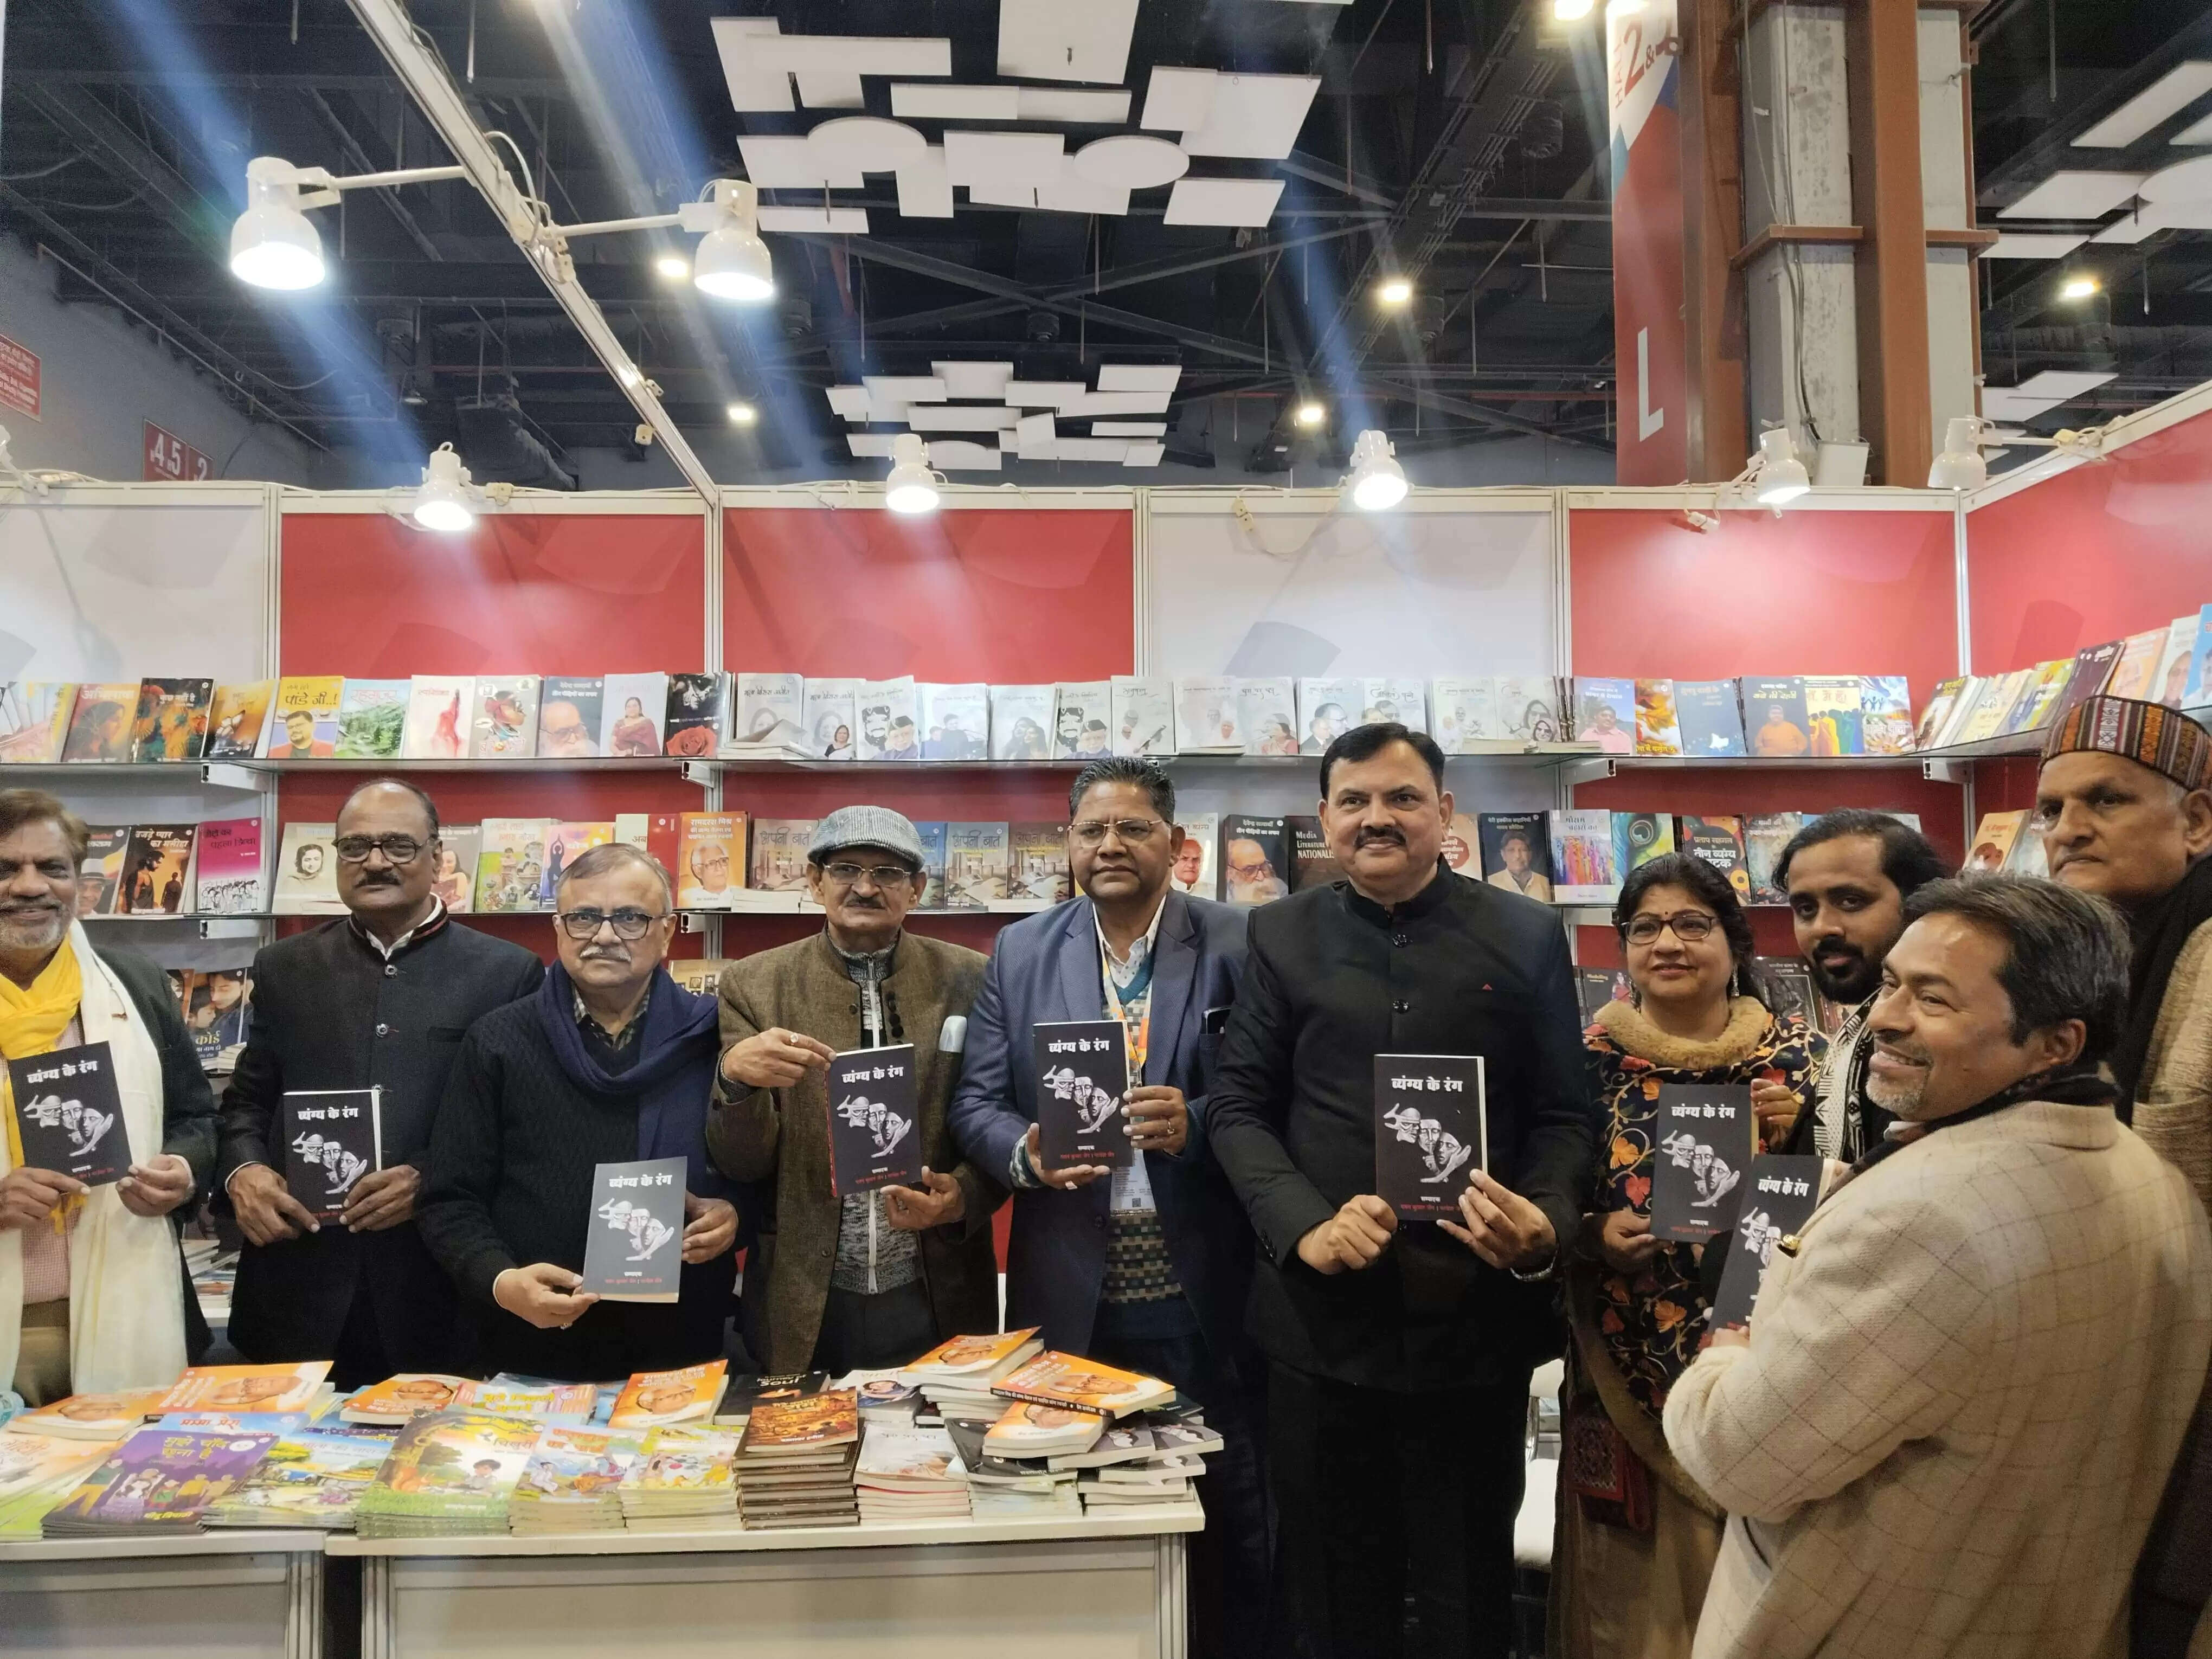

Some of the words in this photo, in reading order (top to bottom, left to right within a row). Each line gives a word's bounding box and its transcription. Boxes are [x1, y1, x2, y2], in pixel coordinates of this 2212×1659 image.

[1637, 327, 1664, 442] L
[163, 838, 190, 847] मसीहा
[760, 827, 790, 846] अपनी
[791, 833, 810, 846] बात
[952, 830, 982, 850] अपनी
[983, 835, 1001, 847] बात
[1693, 847, 1712, 859] तीन
[1712, 847, 1737, 859] व्यंग्य
[195, 1030, 221, 1045] कोई
[1049, 1039, 1076, 1053] व्यंग्य
[1078, 1038, 1091, 1052] के
[1093, 1037, 1110, 1051] रंग
[27, 1069, 60, 1083] व्यंग्य
[61, 1064, 76, 1077] के
[78, 1059, 98, 1073] रंग
[841, 1069, 870, 1083] व्यंग्य
[872, 1066, 885, 1081] के
[887, 1065, 904, 1078] रंग
[1391, 1075, 1424, 1091] व्यंग्य
[1425, 1076, 1441, 1091] के
[1443, 1076, 1463, 1092] रंग
[298, 1108, 325, 1121] व्यंग्य
[327, 1107, 340, 1120] के
[342, 1105, 359, 1118] रंग
[1671, 1103, 1701, 1118] व्यंग्य
[1702, 1103, 1716, 1118] के
[1718, 1103, 1736, 1119] रंग
[608, 1175, 638, 1188] व्यंग्य
[640, 1174, 653, 1187] के
[655, 1172, 673, 1186] रंग
[1758, 1175, 1782, 1194] व्यंग्य
[1782, 1176, 1793, 1195] के
[1793, 1178, 1810, 1197] रंग
